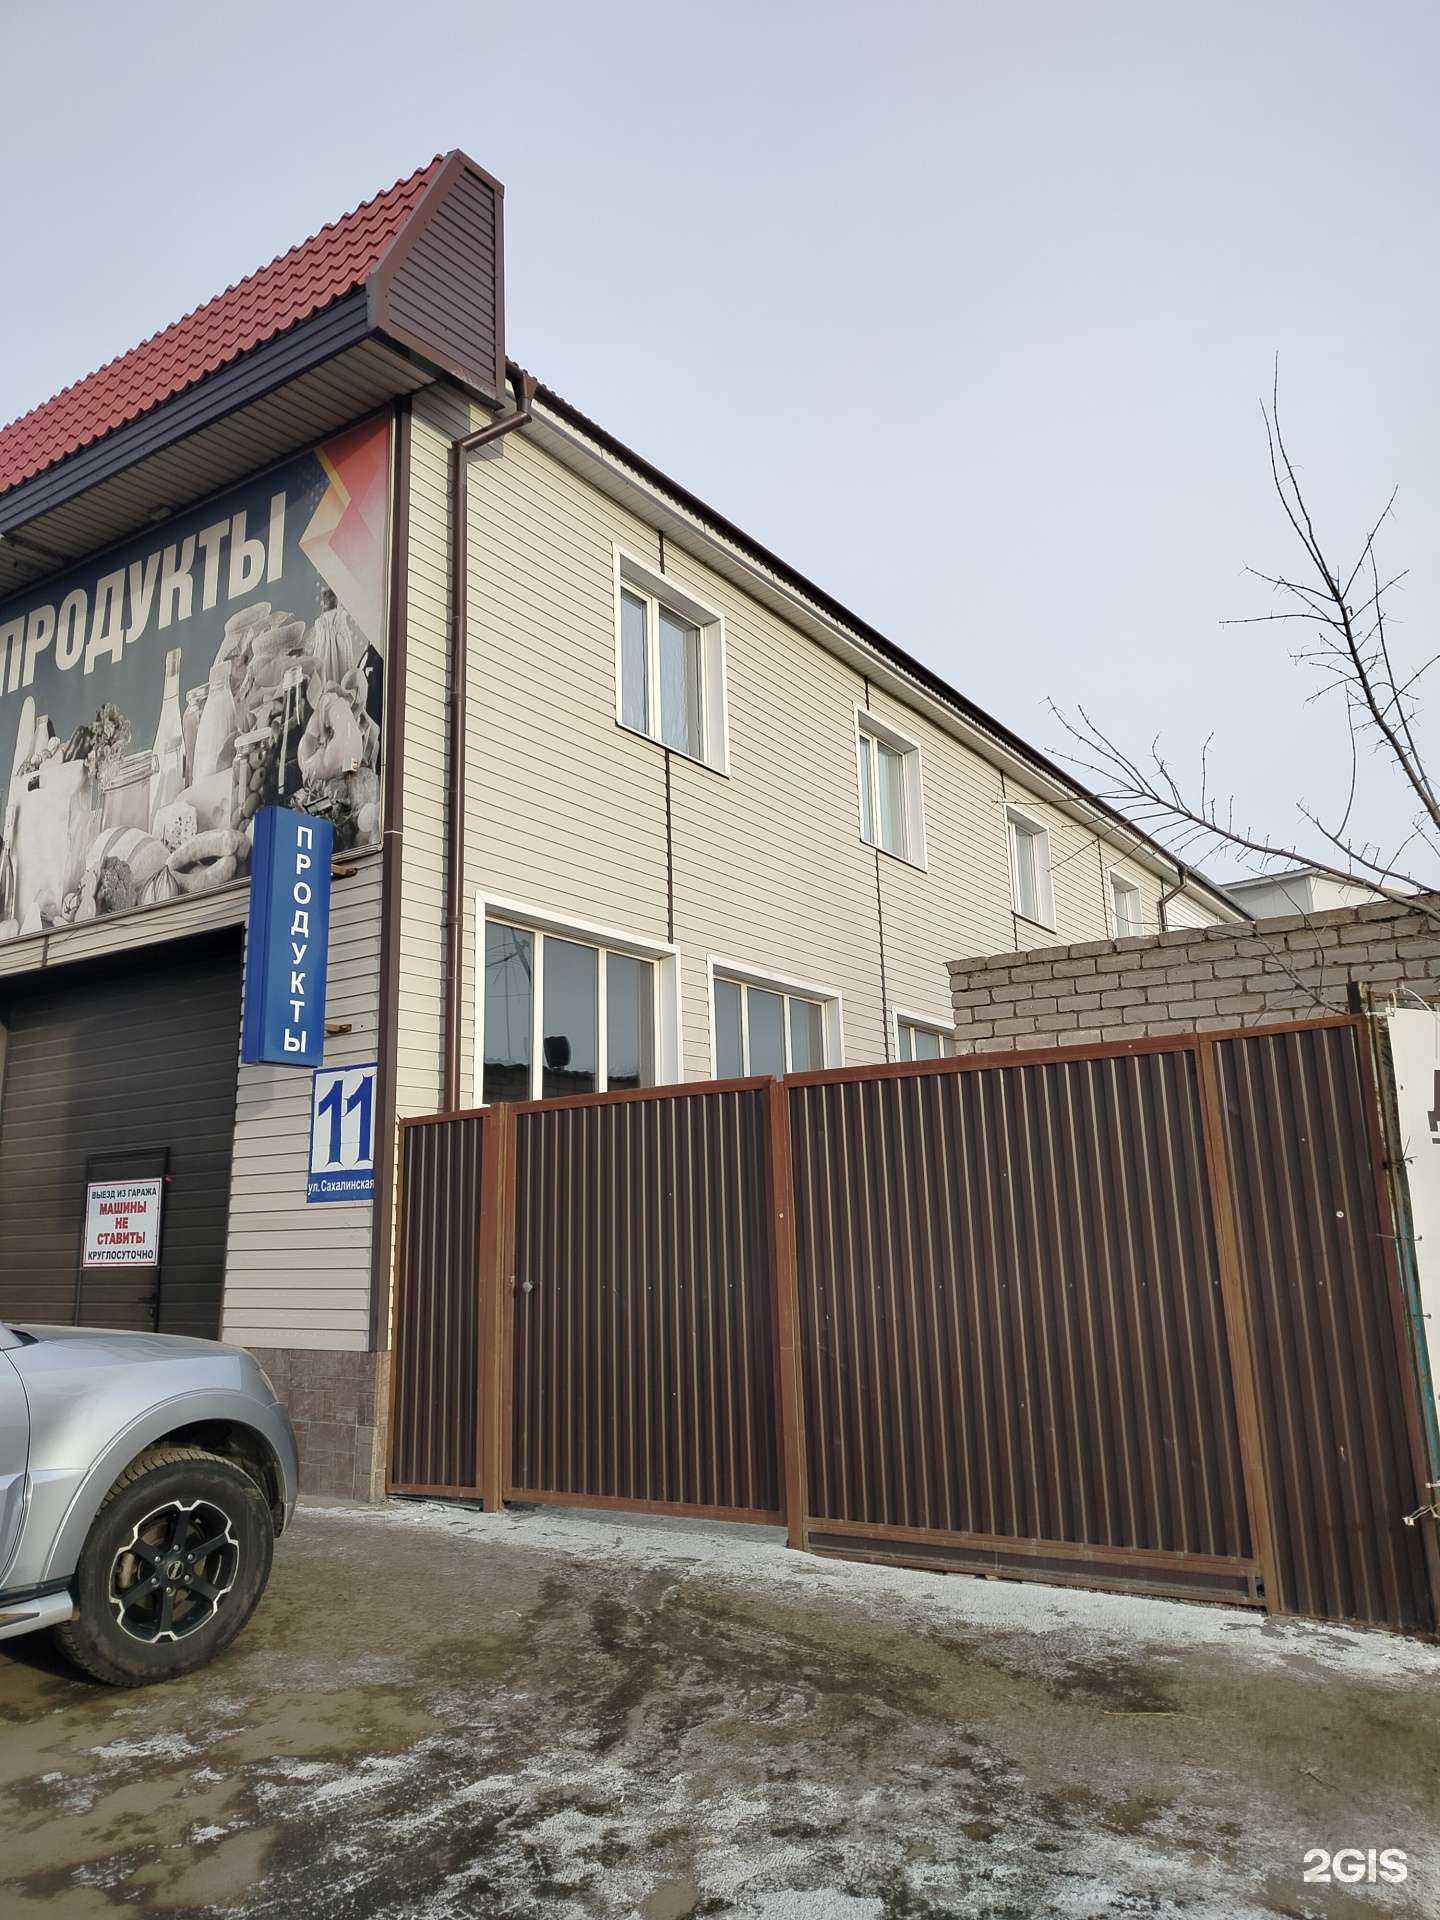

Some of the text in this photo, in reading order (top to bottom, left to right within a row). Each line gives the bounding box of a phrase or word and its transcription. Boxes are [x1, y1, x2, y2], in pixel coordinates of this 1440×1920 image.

[0, 491, 287, 697] ПРОДУКТЫ
[283, 825, 313, 1054] ПРОДУКТЫ
[318, 1073, 376, 1168] 11
[92, 1187, 156, 1199] ВЫЕЗД ИЗ ГАРАЖА
[307, 1179, 375, 1196] ул. Сахалинская
[99, 1201, 146, 1214] МАШИНЫ
[115, 1217, 129, 1229] НЕ
[88, 1249, 154, 1261] КРУГЛОСУТОЧНО
